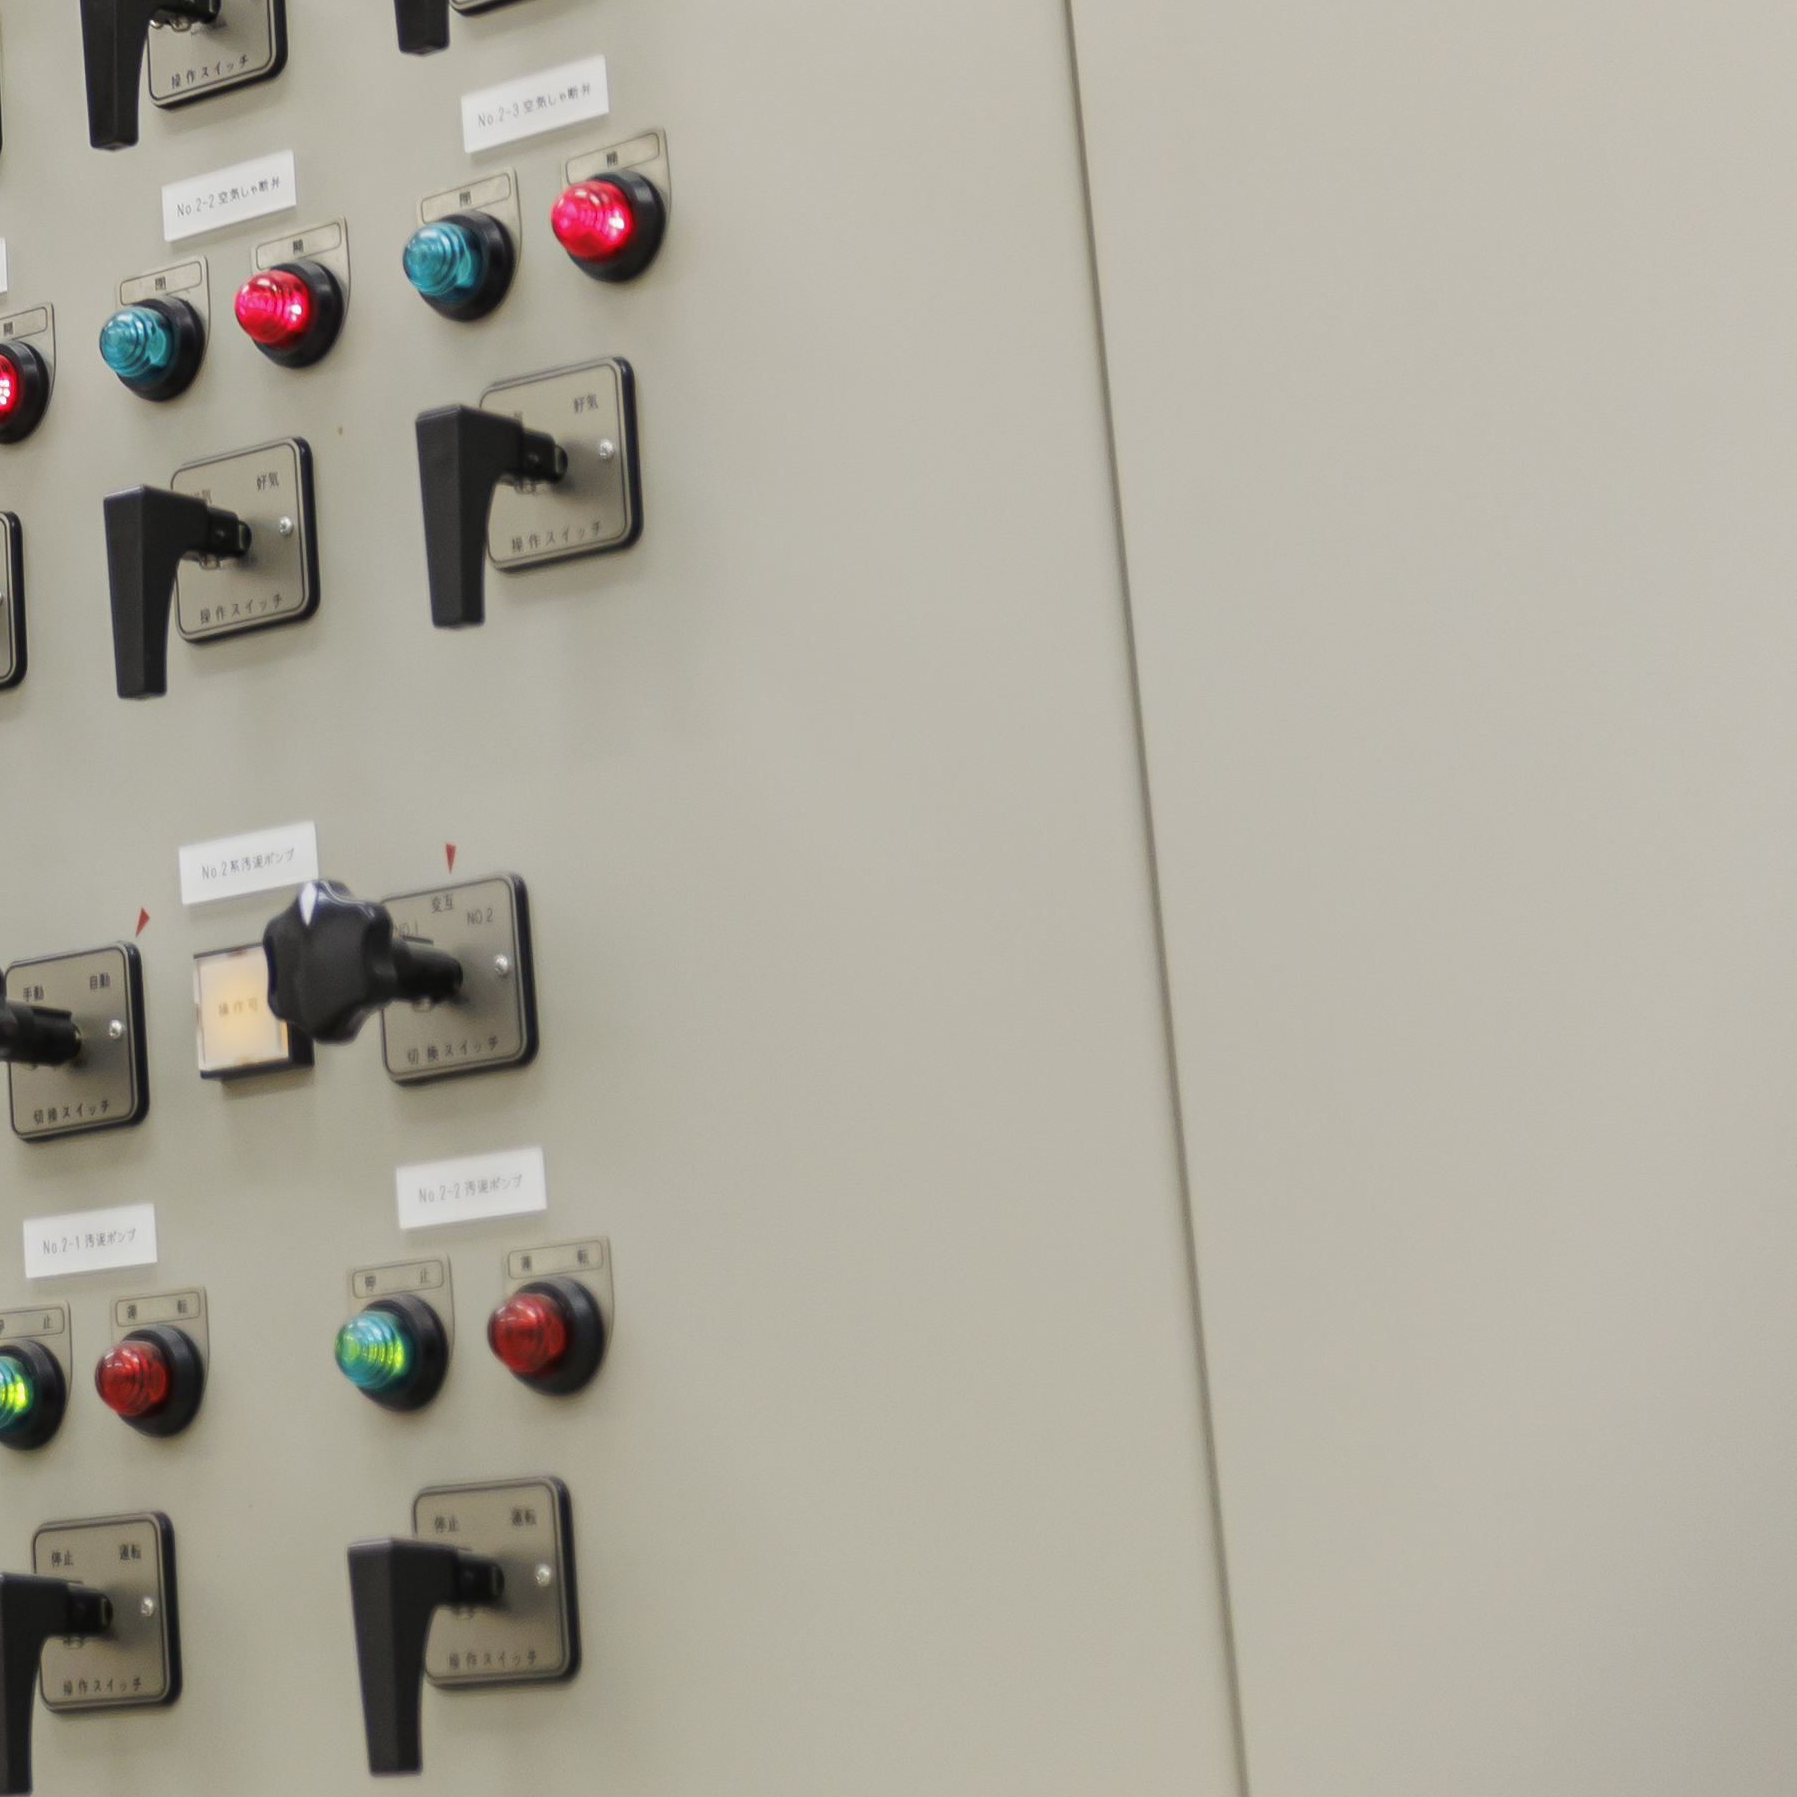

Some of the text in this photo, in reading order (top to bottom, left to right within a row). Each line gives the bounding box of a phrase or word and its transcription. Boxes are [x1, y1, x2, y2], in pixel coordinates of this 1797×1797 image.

[171, 54, 249, 90] 操作スイッチ
[478, 82, 592, 127] No.2-3 空気しゃ断弁
[176, 176, 281, 218] No.2-2 空気しゃ断弁
[573, 393, 599, 414] 好気
[256, 472, 280, 492] 好気
[511, 520, 603, 553] 操作スイッチ
[200, 593, 283, 625] 操作スイッチ
[431, 895, 454, 913] 交互
[467, 908, 494, 926] NO.2
[89, 972, 111, 990] 自動
[22, 986, 44, 1003] 手動
[407, 1035, 500, 1066] 切換スイッチ
[34, 1098, 110, 1125] 切換スイッチ
[419, 1174, 523, 1204] No.2-2 汚泥ポンプ
[43, 1227, 136, 1255] No.2-1 汚泥ポンプ
[434, 1515, 459, 1535] 停止
[511, 1507, 537, 1528] 運転
[51, 1549, 74, 1569] 停止
[119, 1543, 142, 1563] 運転
[63, 1676, 142, 1697] 操作スイッチ
